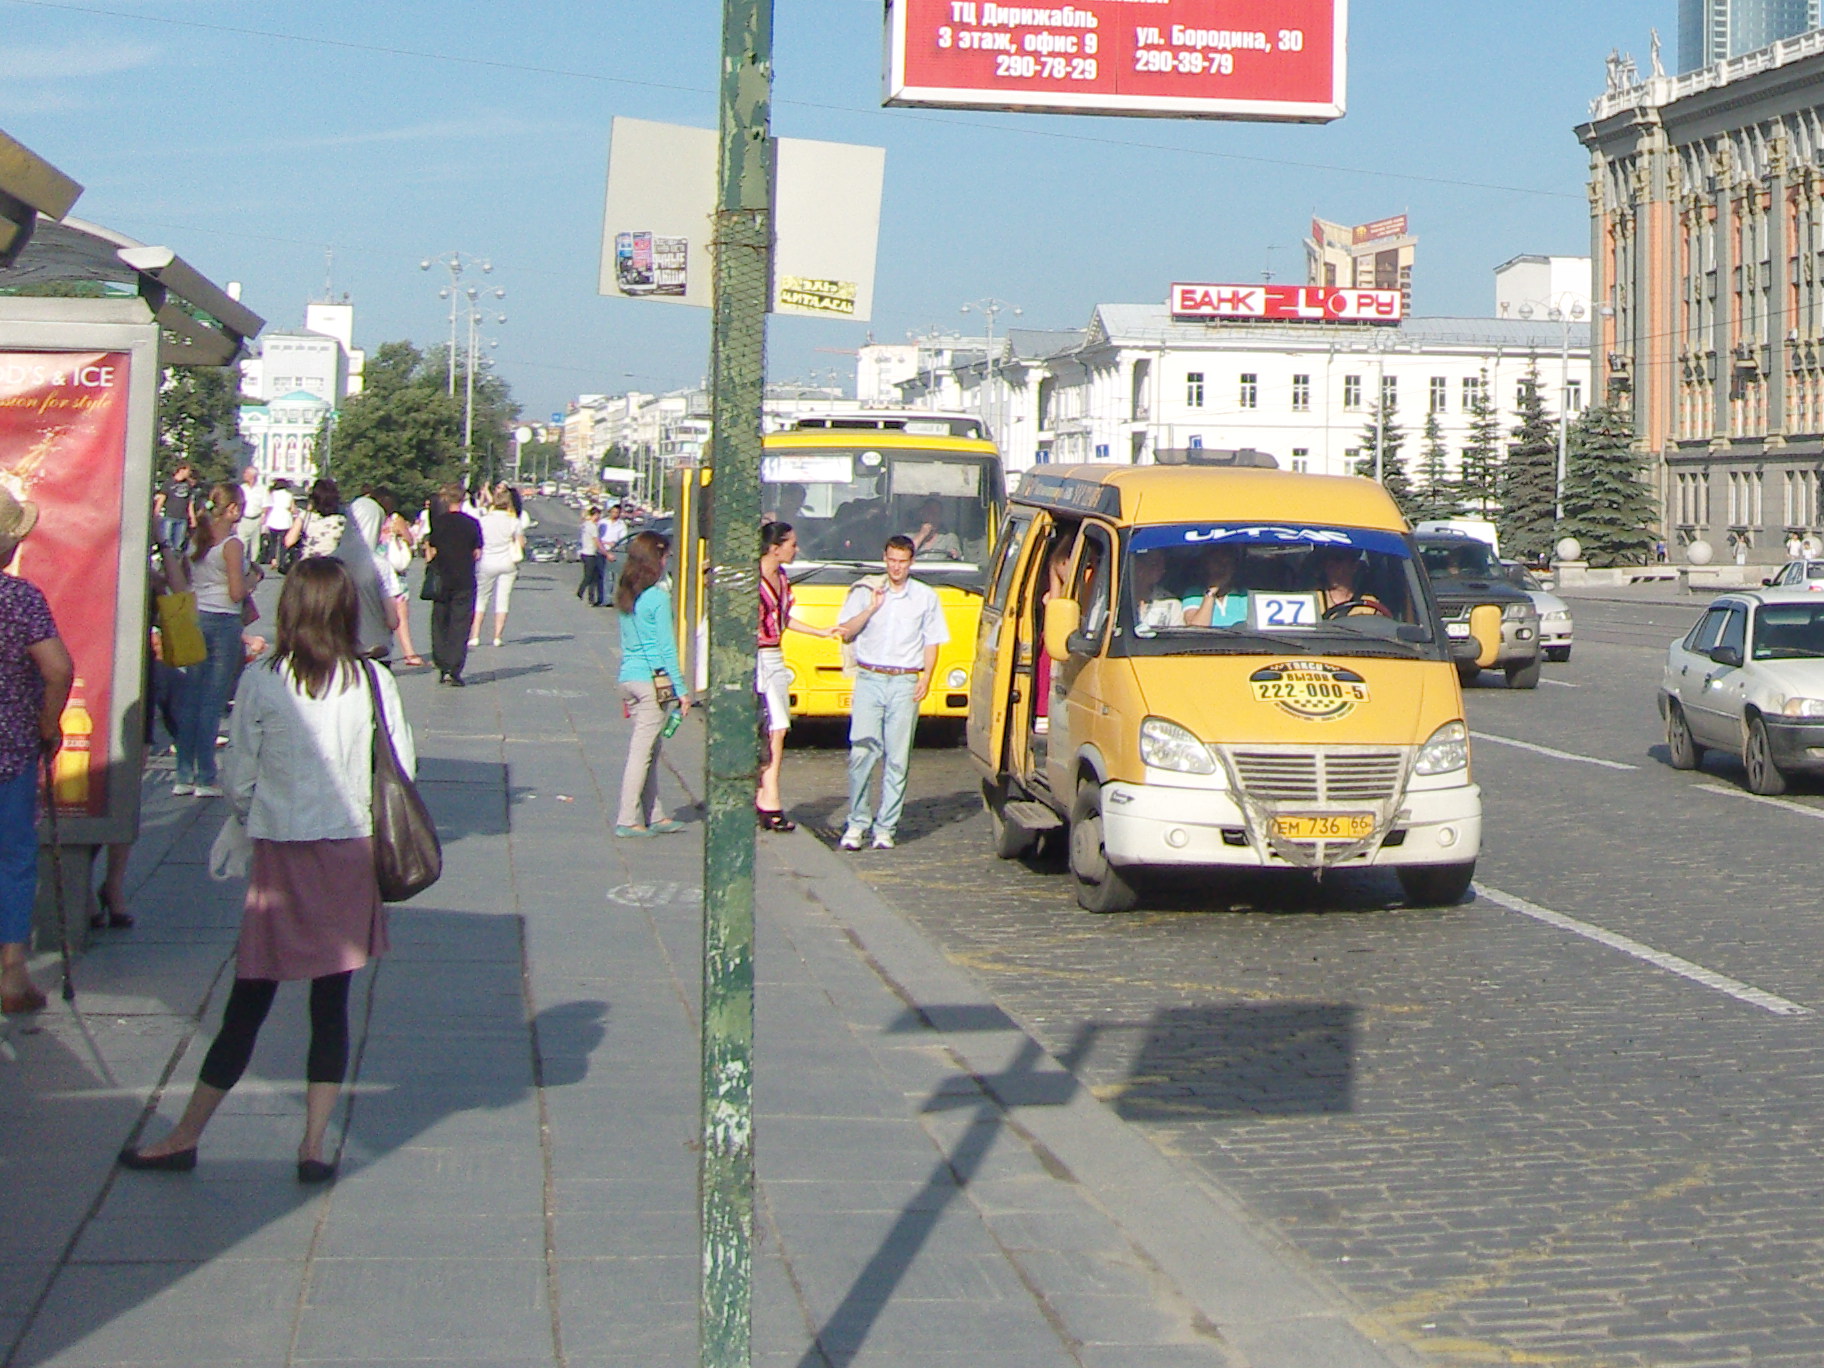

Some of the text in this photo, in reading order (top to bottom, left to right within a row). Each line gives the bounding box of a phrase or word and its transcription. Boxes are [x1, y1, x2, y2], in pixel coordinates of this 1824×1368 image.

[951, 3, 1098, 29] ТЦ Дирижабль
[938, 27, 1098, 55] 3 этаж, офис 9
[1136, 26, 1303, 53] ул. Бородина, 30
[996, 56, 1097, 80] 290-78-29
[1135, 50, 1234, 74] 290-39-79
[1180, 289, 1256, 312] БАНК
[52, 370, 66, 386] &
[73, 366, 115, 387] ICE
[37, 390, 69, 415] for
[1265, 599, 1305, 625] 27
[1259, 683, 1364, 700] 222-000-5
[1307, 817, 1341, 835] 736
[1351, 816, 1369, 829] 66
